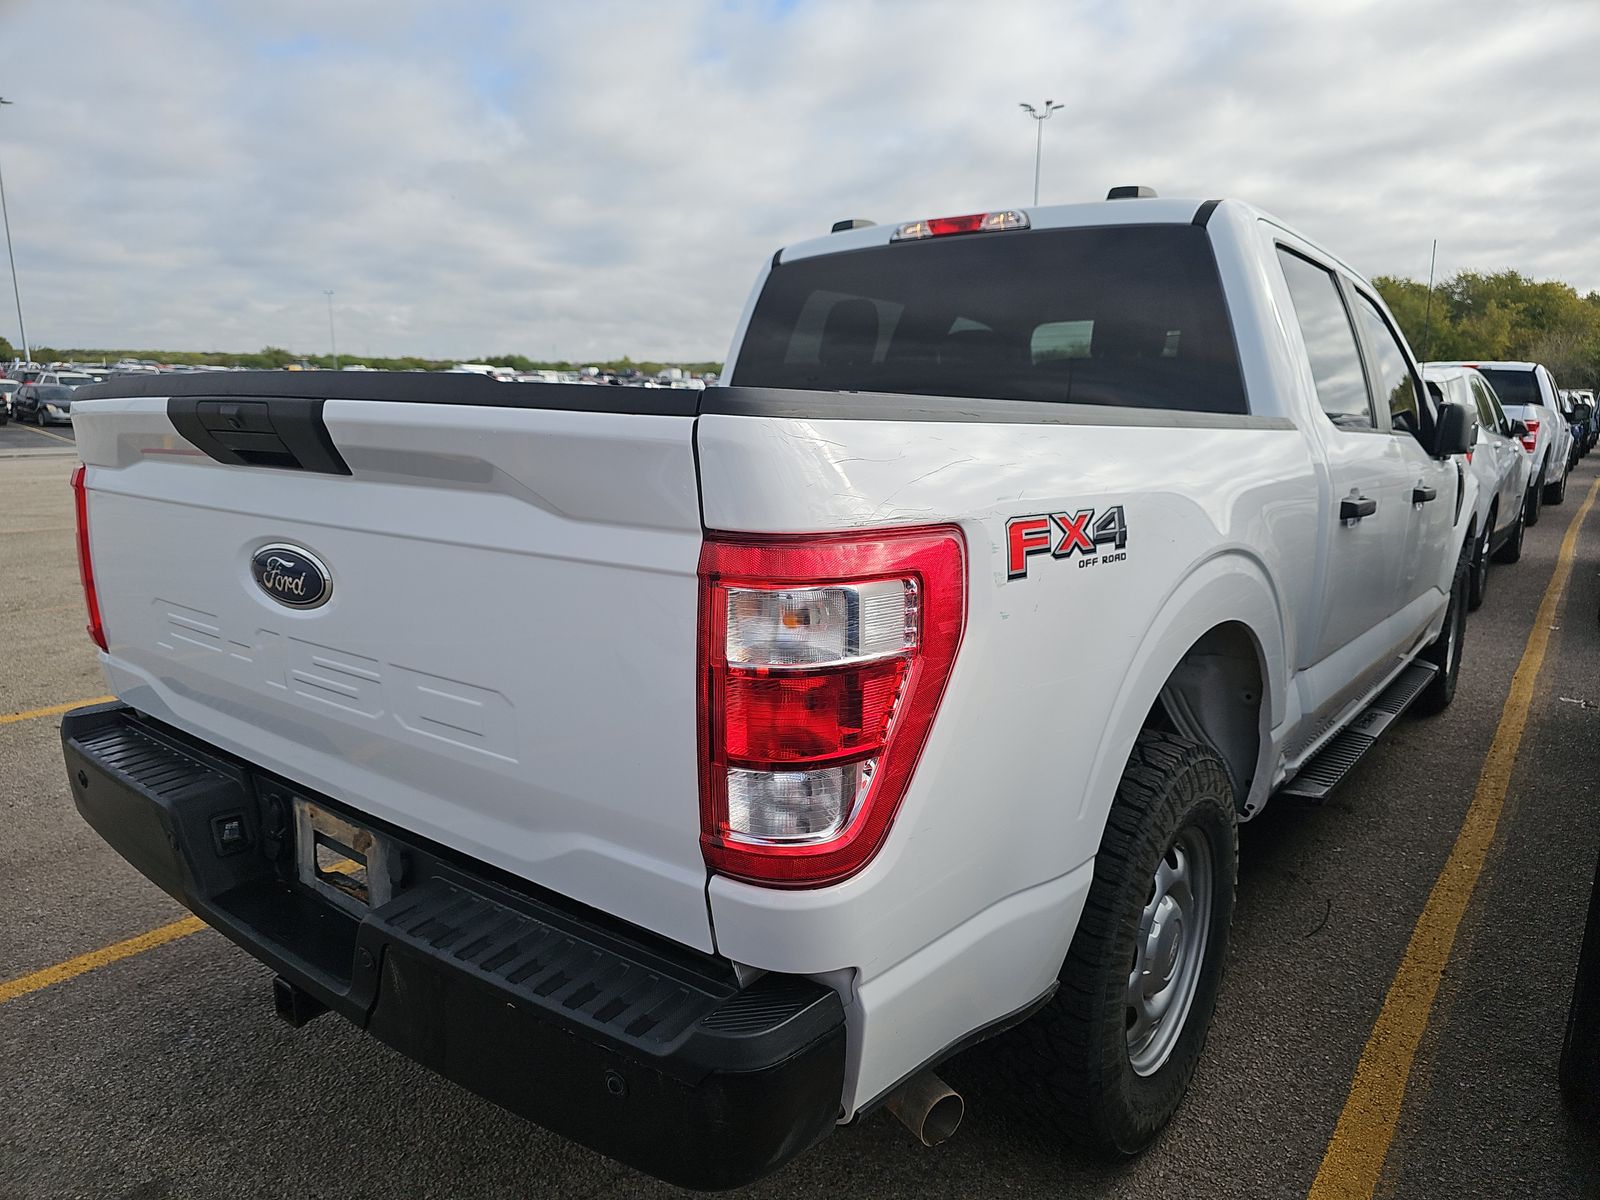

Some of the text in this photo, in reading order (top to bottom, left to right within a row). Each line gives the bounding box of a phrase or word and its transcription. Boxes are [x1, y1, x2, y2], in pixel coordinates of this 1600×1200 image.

[1005, 505, 1127, 581] FX4
[1078, 552, 1127, 569] OFF ROAD
[263, 556, 306, 596] Ford
